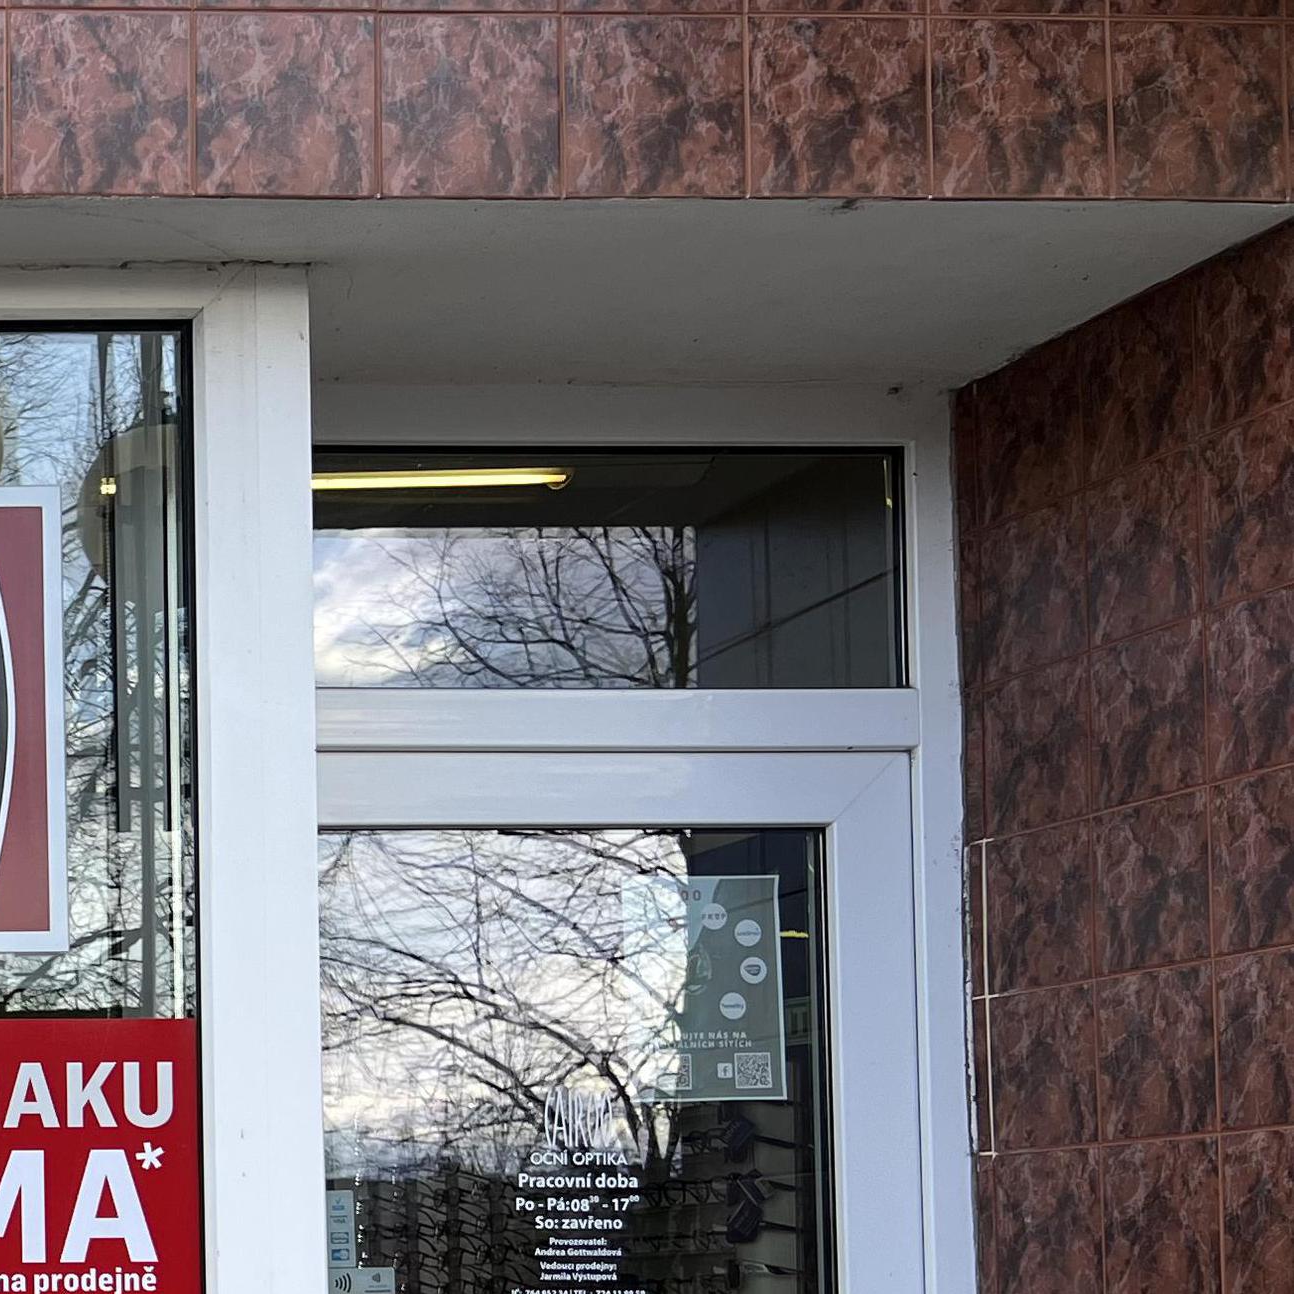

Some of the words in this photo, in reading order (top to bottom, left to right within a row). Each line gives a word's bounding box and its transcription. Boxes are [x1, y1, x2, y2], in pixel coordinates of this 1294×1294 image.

[530, 1149, 568, 1165] OČNÍ
[572, 1152, 628, 1165] OPTIKA
[518, 1173, 591, 1188] Pracovní
[595, 1173, 639, 1188] doba
[515, 1197, 535, 1211] Po
[534, 1216, 559, 1230] So:
[562, 1216, 623, 1230] zavřeno
[549, 1237, 607, 1246] Provozovatel:
[534, 1247, 566, 1256] Andrea
[567, 1247, 622, 1256] Gottwaldová
[576, 1261, 617, 1272] prodejny:
[539, 1272, 571, 1281] Jarmila
